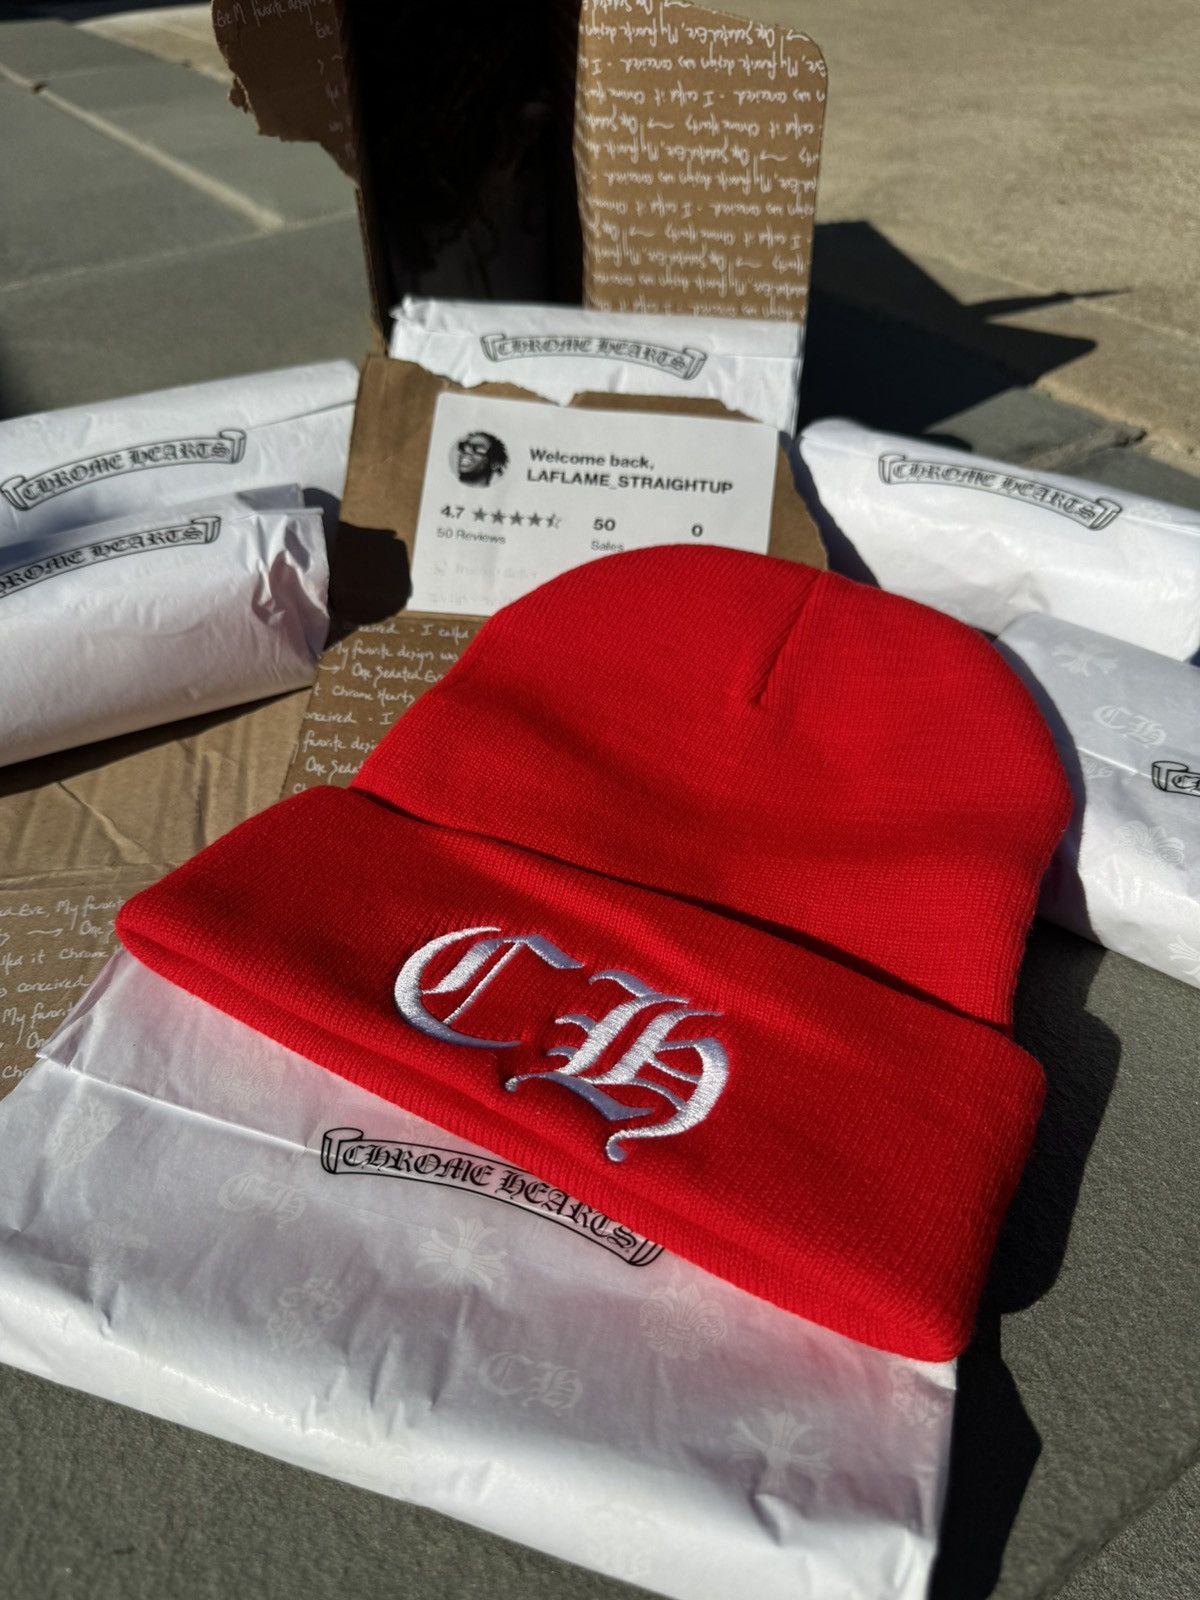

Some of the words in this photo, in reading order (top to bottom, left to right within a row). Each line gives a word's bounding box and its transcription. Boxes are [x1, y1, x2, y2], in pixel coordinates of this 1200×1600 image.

[497, 337, 593, 356] CHROME
[598, 338, 687, 370] HEARTS
[22, 457, 124, 501] CHROME
[129, 441, 231, 468] HEARTS
[530, 449, 605, 467] Welcome
[609, 455, 655, 471] back,
[527, 470, 733, 494] LAFLAME_STRAIGHTUP
[893, 463, 995, 488] CHROME
[1001, 477, 1097, 520] HEARTS
[440, 505, 465, 521] 4.7
[593, 518, 616, 532] 50
[456, 530, 506, 545] Reviews
[0, 551, 85, 593] ROME
[91, 526, 204, 560] HEARTS
[83, 895, 124, 918] favorit
[342, 1143, 495, 1187] CHROME
[494, 1168, 639, 1250] HEARTS
